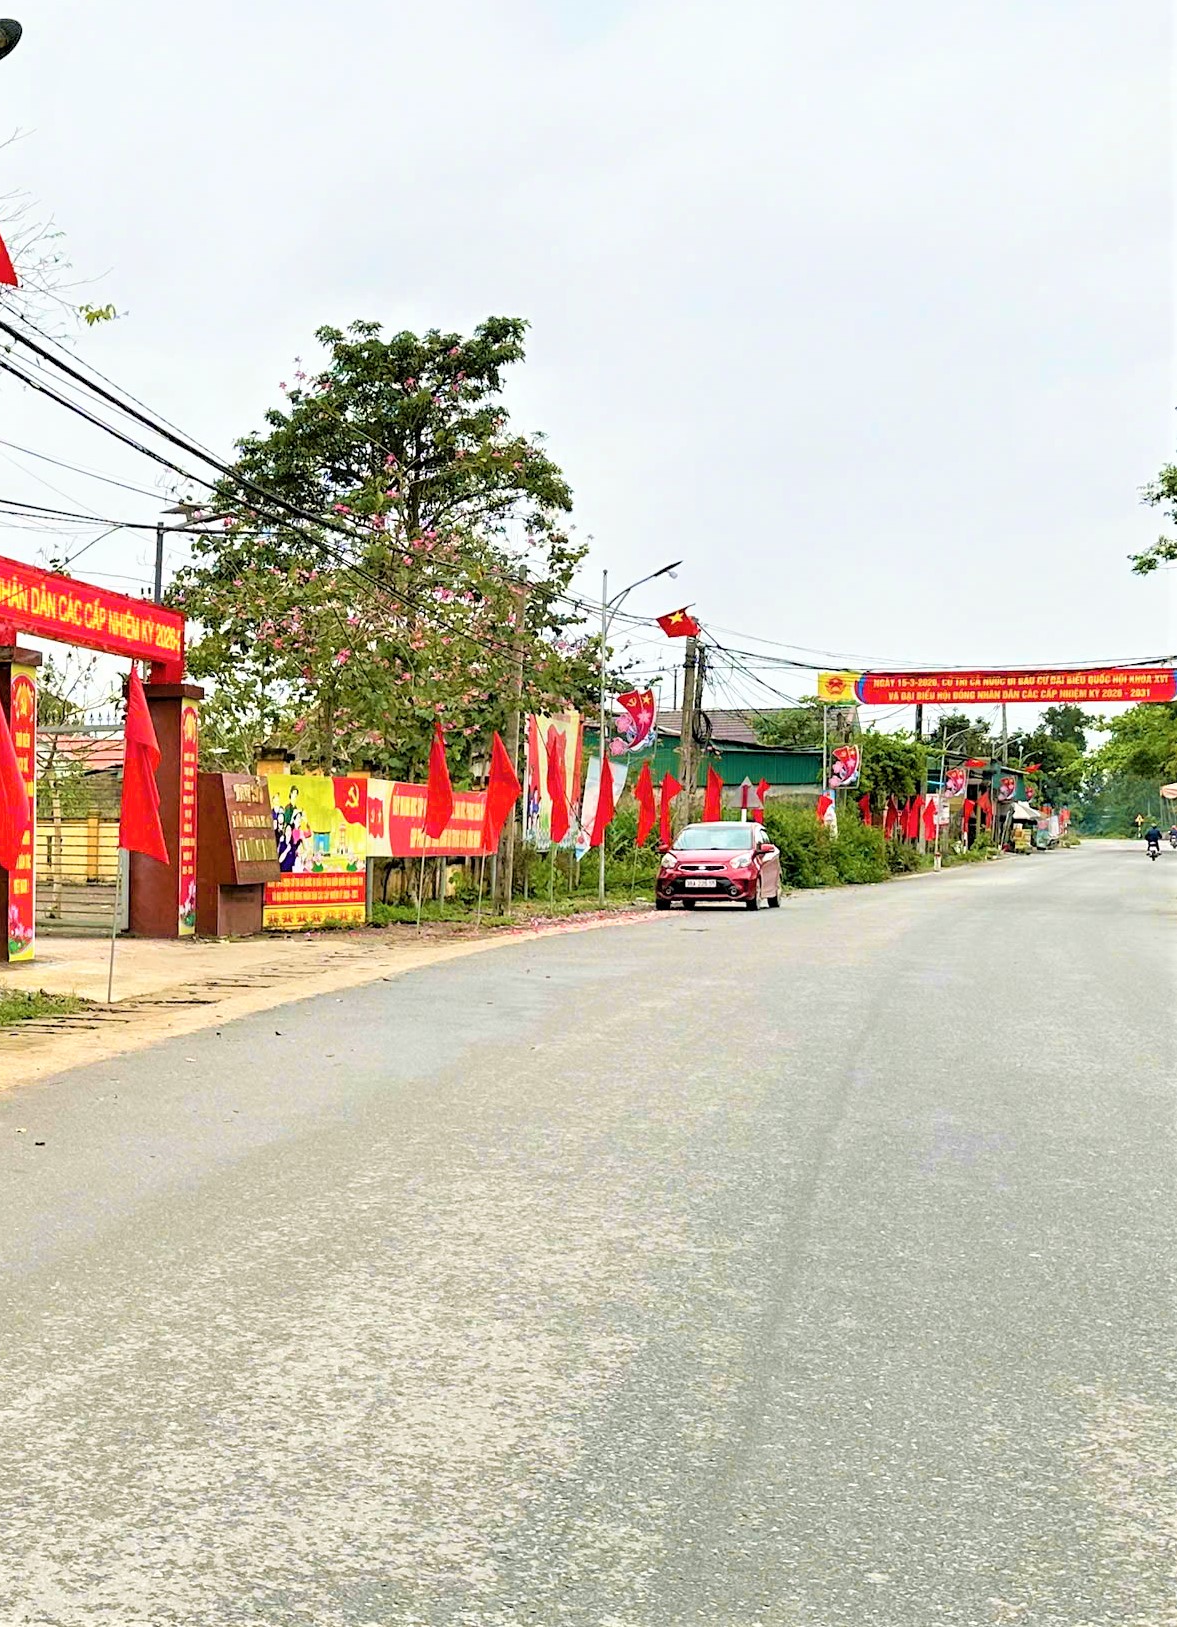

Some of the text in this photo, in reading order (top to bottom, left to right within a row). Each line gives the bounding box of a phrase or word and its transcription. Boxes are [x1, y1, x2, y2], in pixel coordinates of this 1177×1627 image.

[30, 582, 56, 619] DÂN
[58, 591, 82, 626] CÁC
[84, 598, 106, 631] CẤP
[108, 608, 141, 643] NHIỆM
